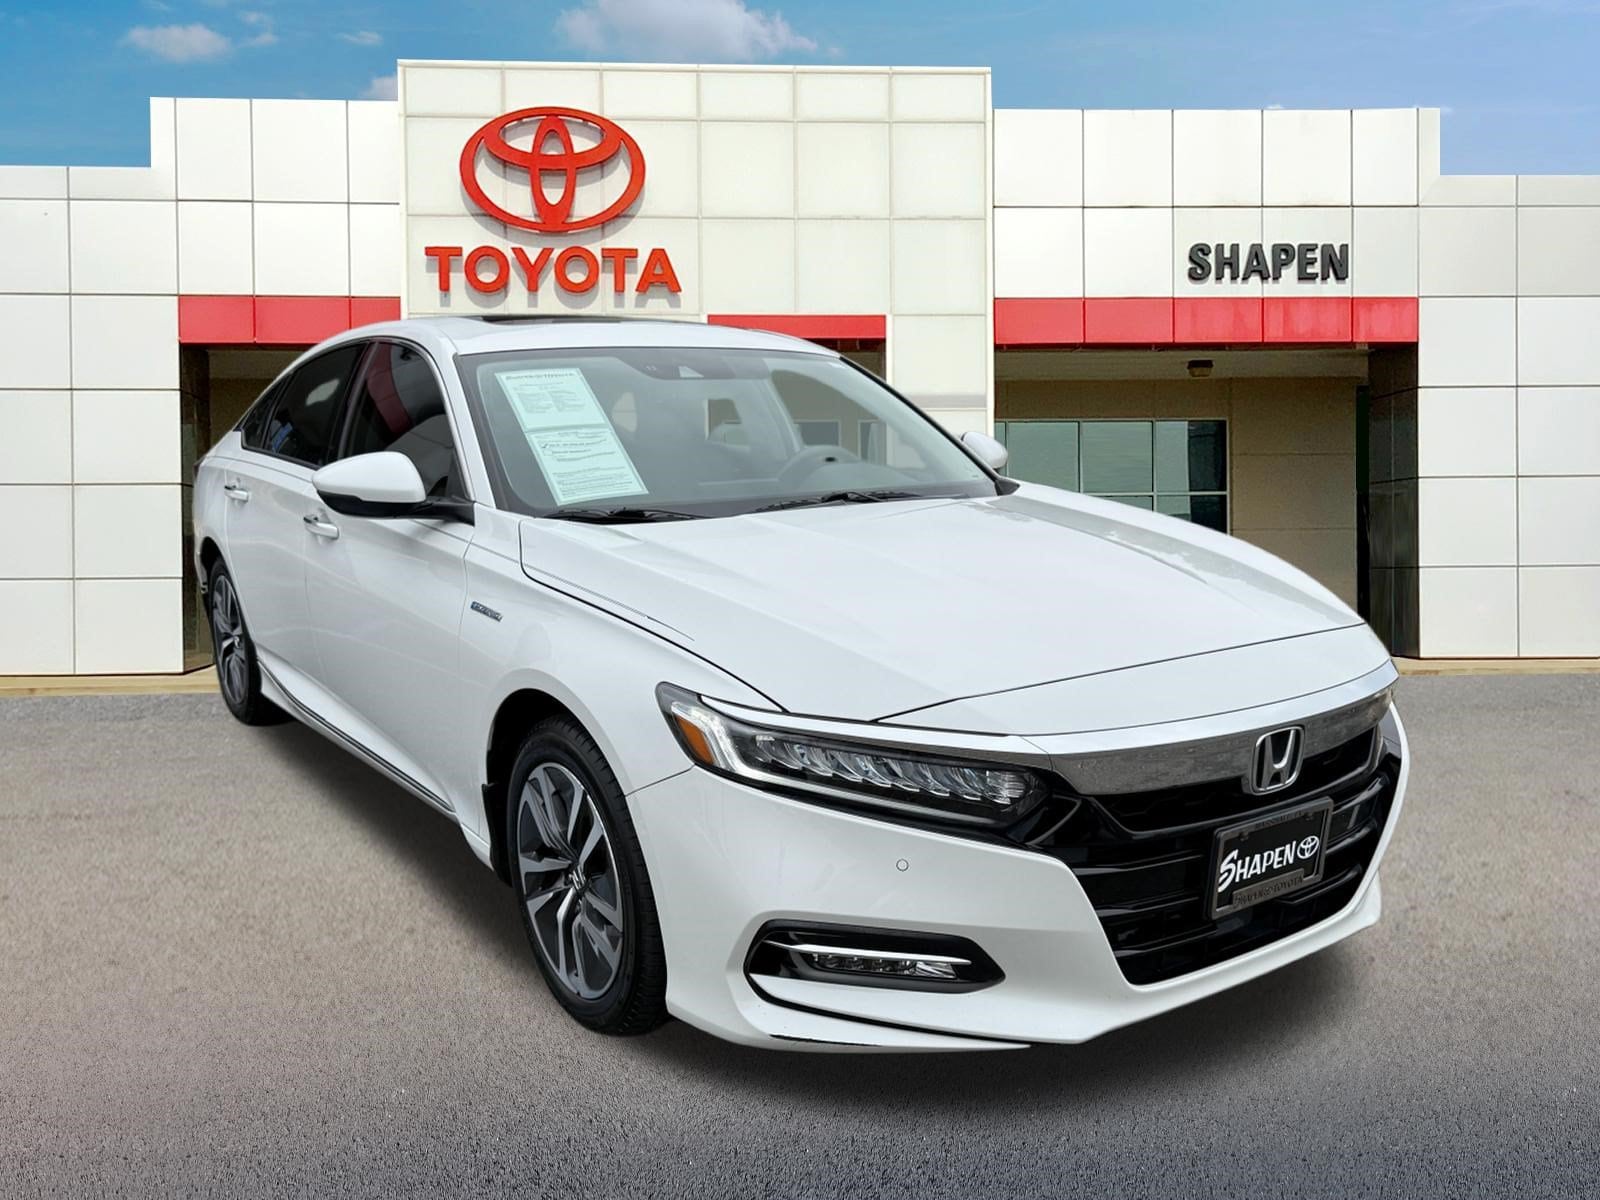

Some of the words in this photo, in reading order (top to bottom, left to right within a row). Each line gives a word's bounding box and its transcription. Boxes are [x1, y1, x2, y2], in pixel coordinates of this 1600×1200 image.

[424, 245, 682, 293] TOYOTA
[1188, 243, 1349, 281] SHAPEN
[1217, 840, 1297, 893] SHAPEN
